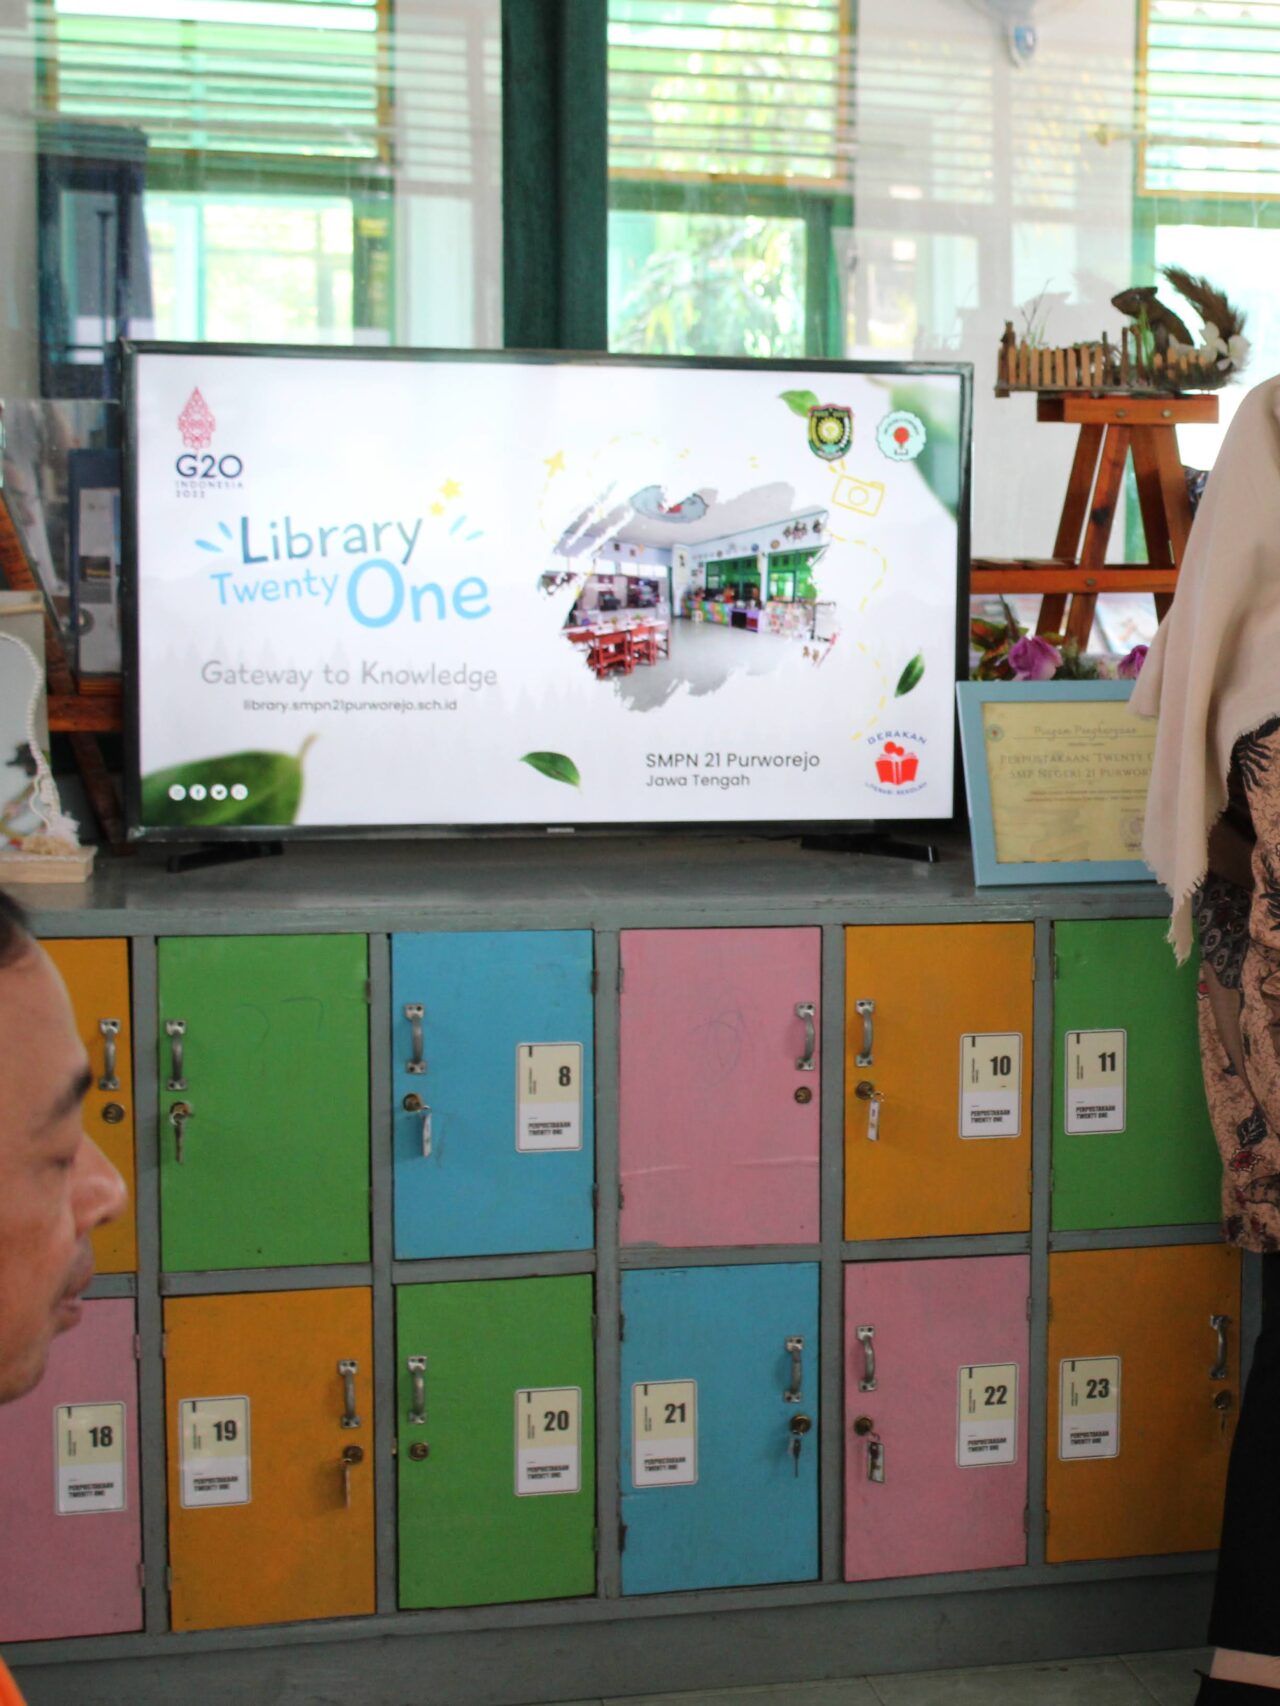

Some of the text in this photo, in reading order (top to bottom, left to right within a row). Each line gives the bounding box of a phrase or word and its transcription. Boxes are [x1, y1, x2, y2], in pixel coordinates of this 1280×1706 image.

[241, 515, 423, 566] Library
[210, 558, 492, 628] Twenty One
[201, 660, 498, 691] Gateway to Knowledge
[646, 752, 821, 771] SMPN 21 Purworejo
[646, 773, 750, 790] Jawa Tengah
[990, 1055, 1011, 1076] 10
[1098, 1052, 1116, 1072] 11
[558, 1066, 571, 1087] 8
[984, 1385, 1007, 1406] 22
[1086, 1379, 1110, 1399] 23
[544, 1410, 569, 1432] 20
[664, 1403, 686, 1424] 21
[89, 1426, 113, 1448] 18
[213, 1420, 237, 1442] 19
